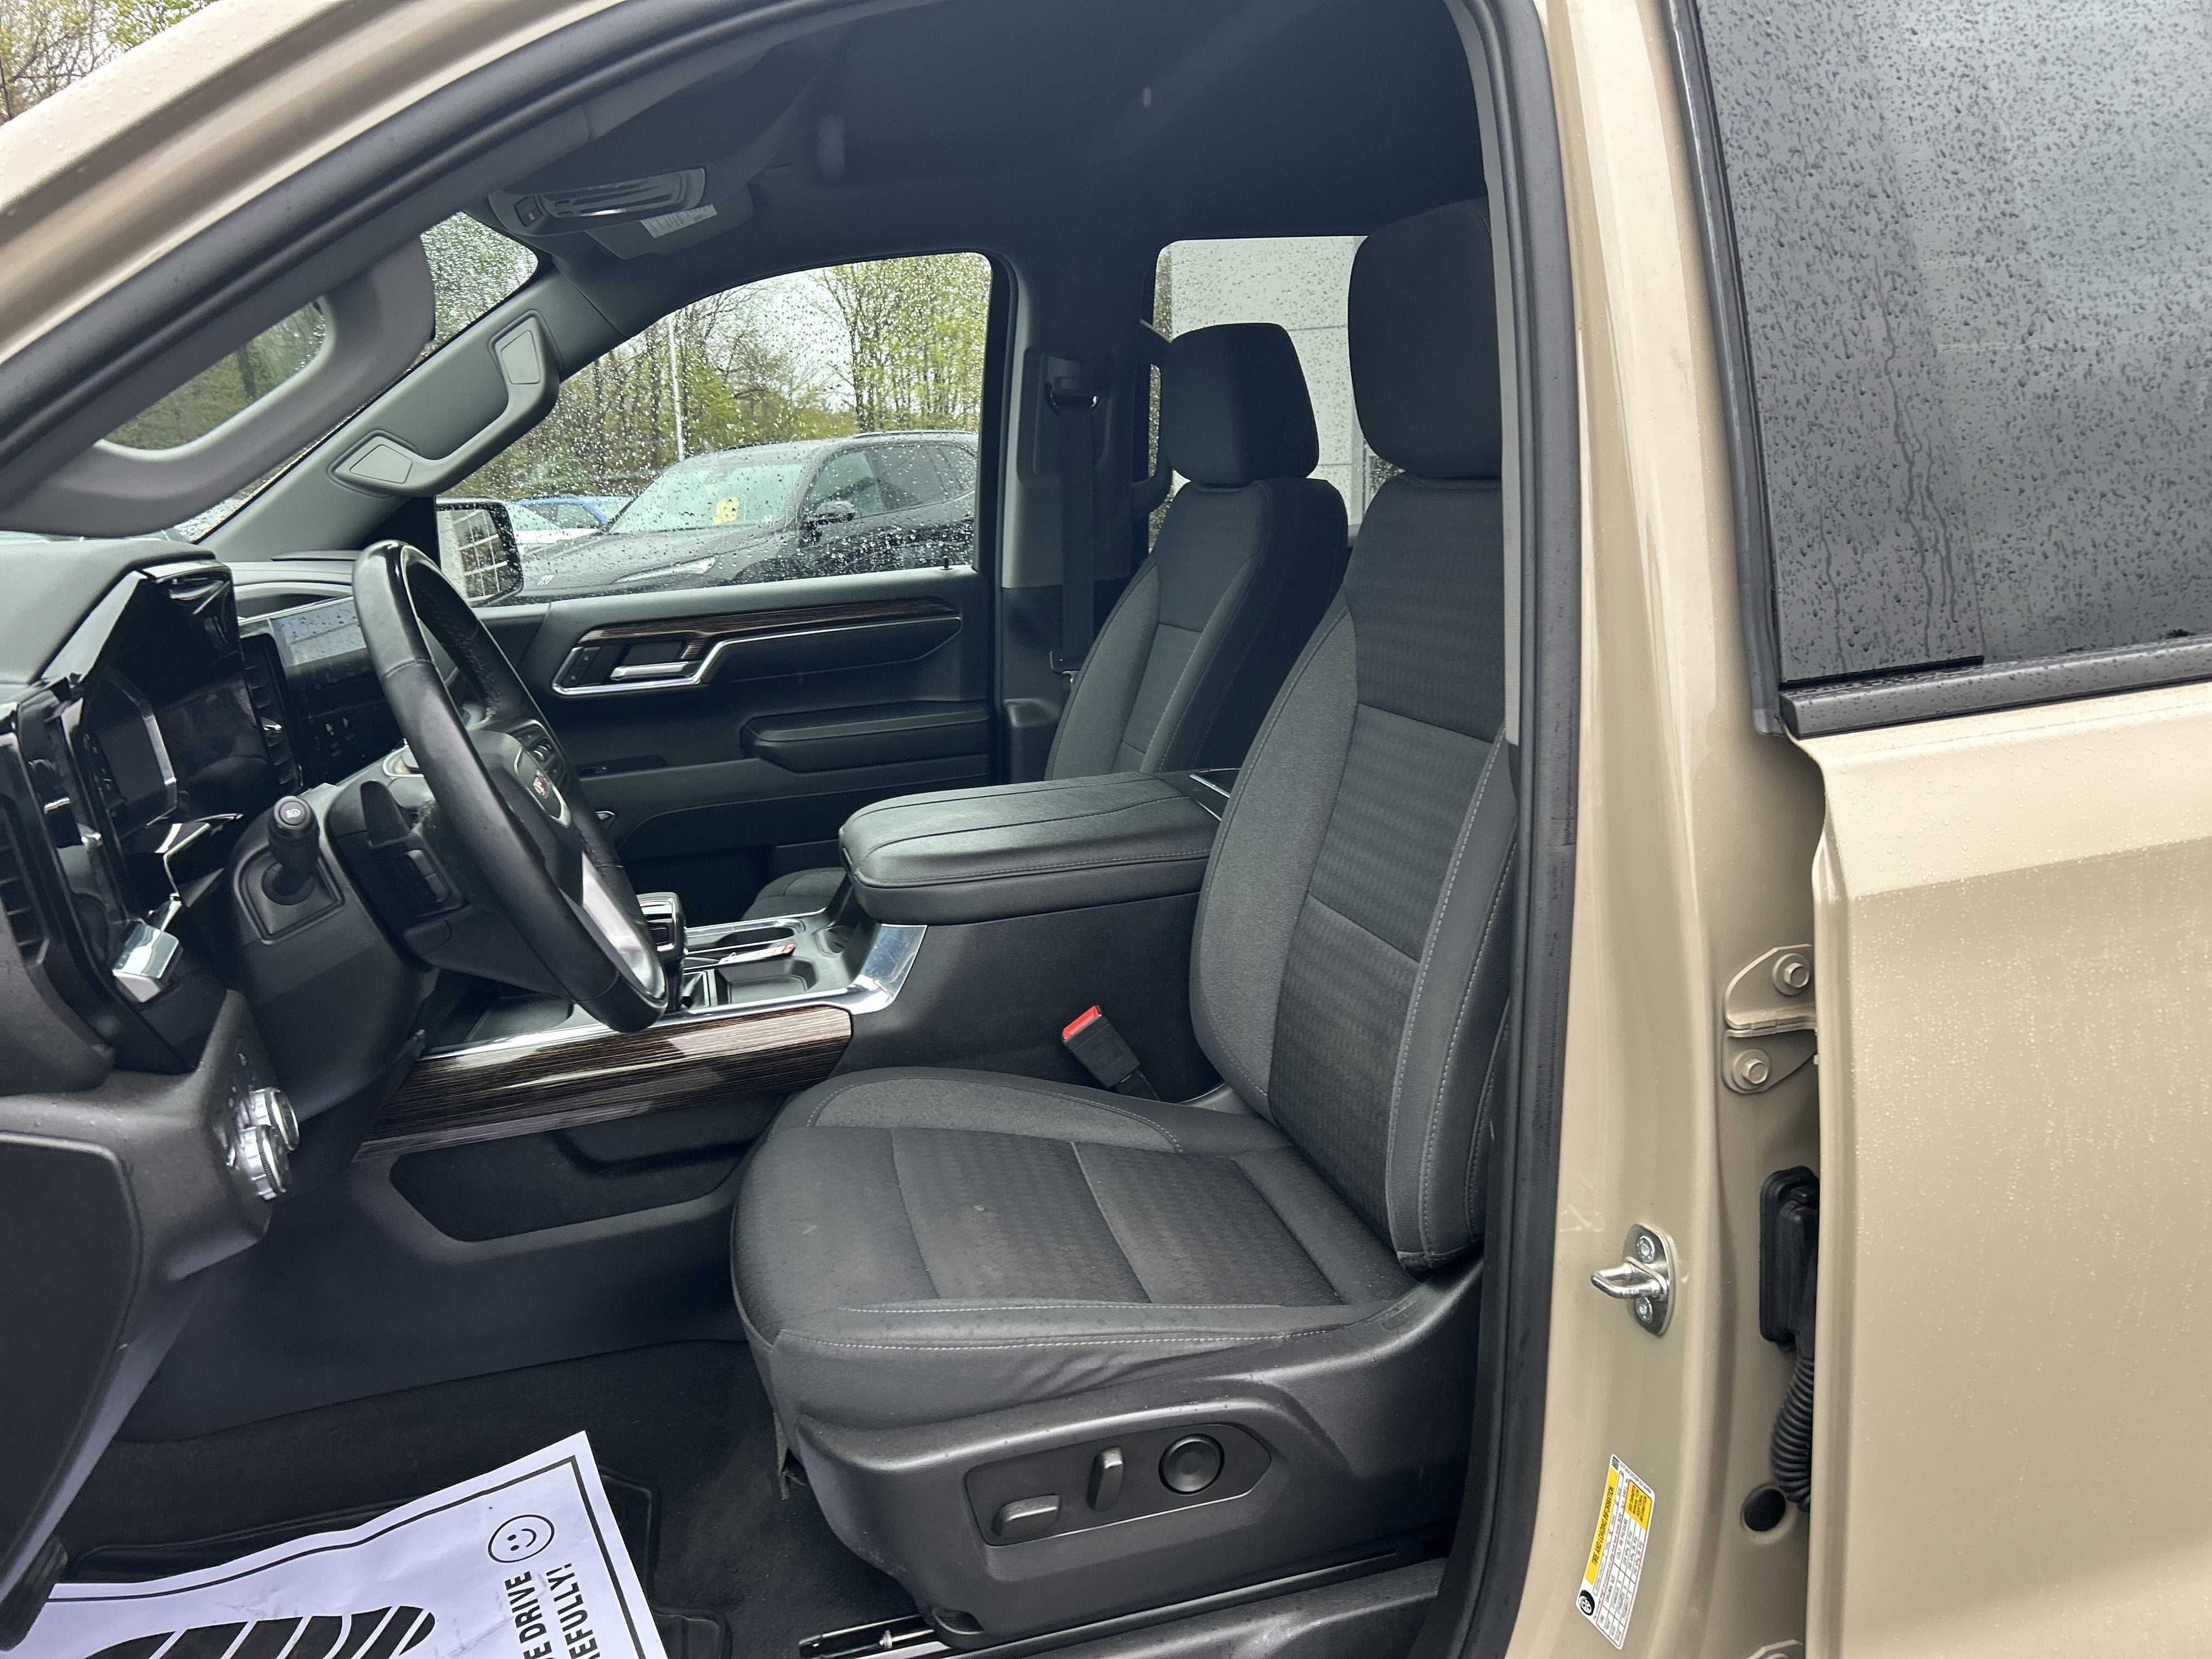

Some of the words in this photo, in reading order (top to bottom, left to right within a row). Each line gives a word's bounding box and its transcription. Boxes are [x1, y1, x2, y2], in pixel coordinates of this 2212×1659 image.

[1591, 1551, 1599, 1566] TIRE
[1597, 1517, 1607, 1543] LOADING
[1602, 1484, 1615, 1521] INFORMATION
[504, 1571, 547, 1644] DRIVE
[546, 1563, 601, 1659] EFULLY!
[523, 1641, 554, 1659] E
